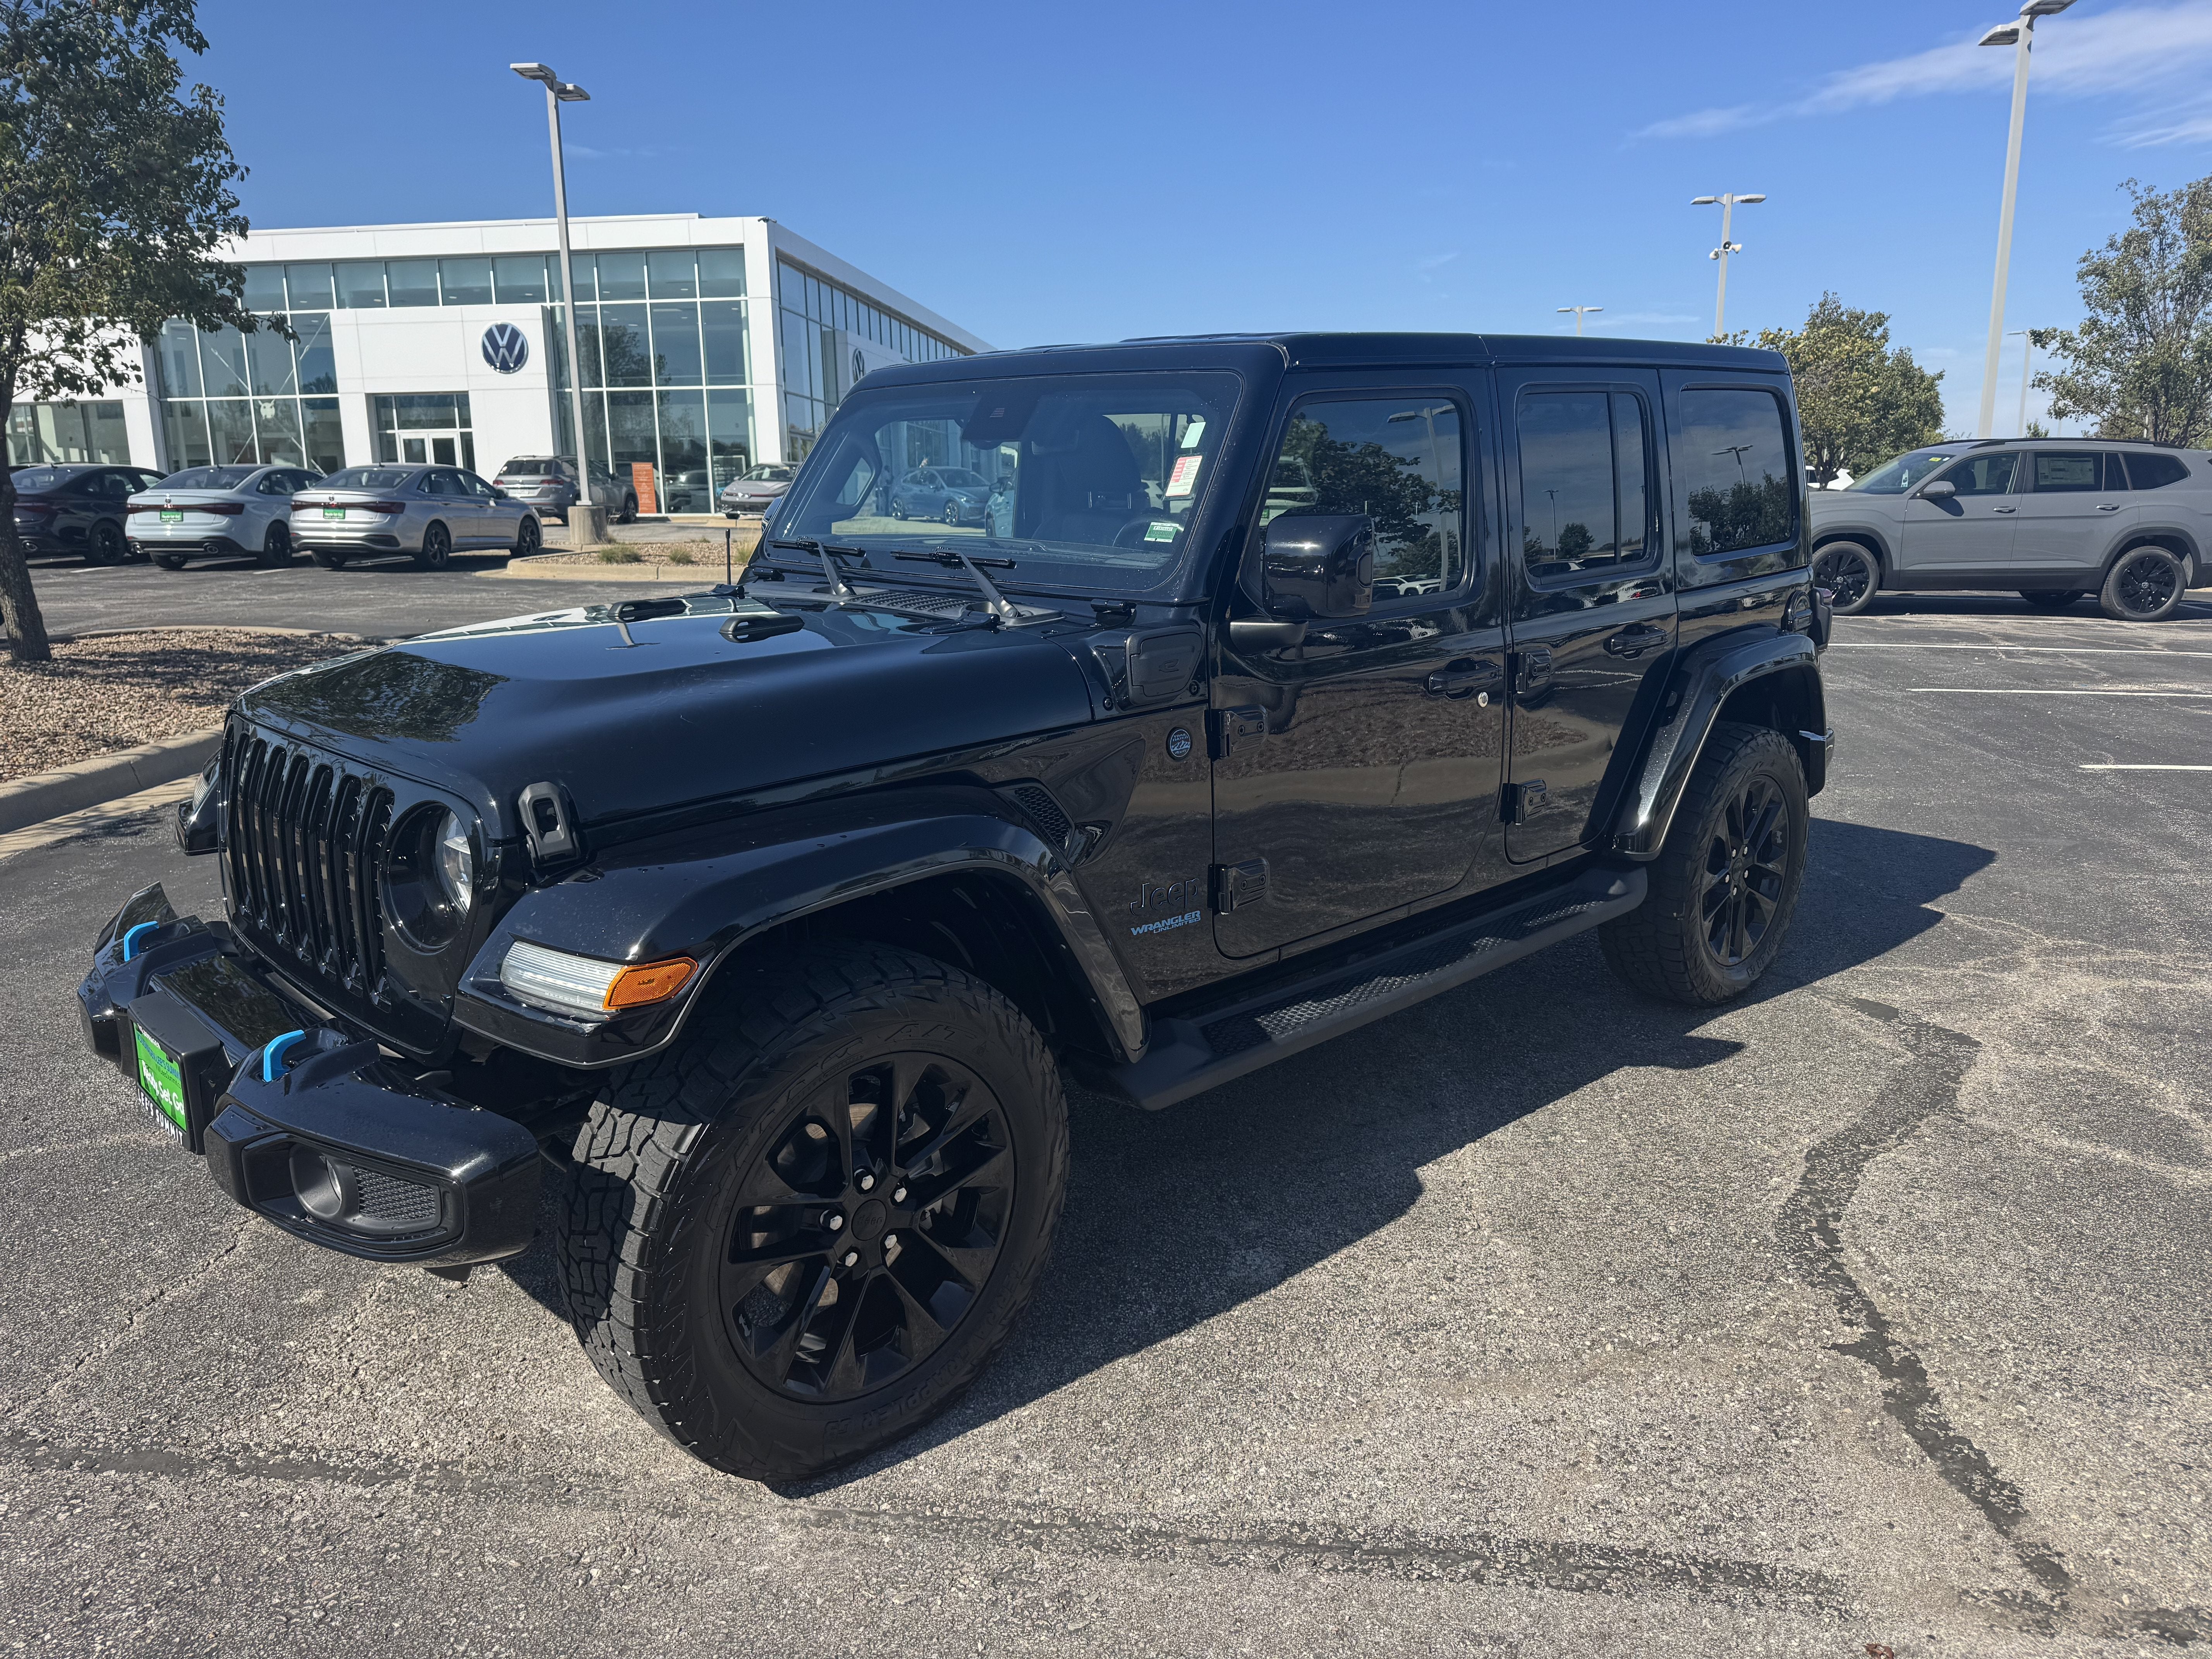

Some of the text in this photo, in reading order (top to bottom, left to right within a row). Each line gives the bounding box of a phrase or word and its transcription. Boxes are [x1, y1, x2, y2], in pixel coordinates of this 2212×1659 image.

[482, 323, 527, 373] VW
[1130, 878, 1200, 916] Jeep
[1131, 910, 1200, 935] WRANGLER
[1154, 917, 1200, 933] UNLIMITED
[138, 1088, 183, 1146] LEE'S SUMMIT
